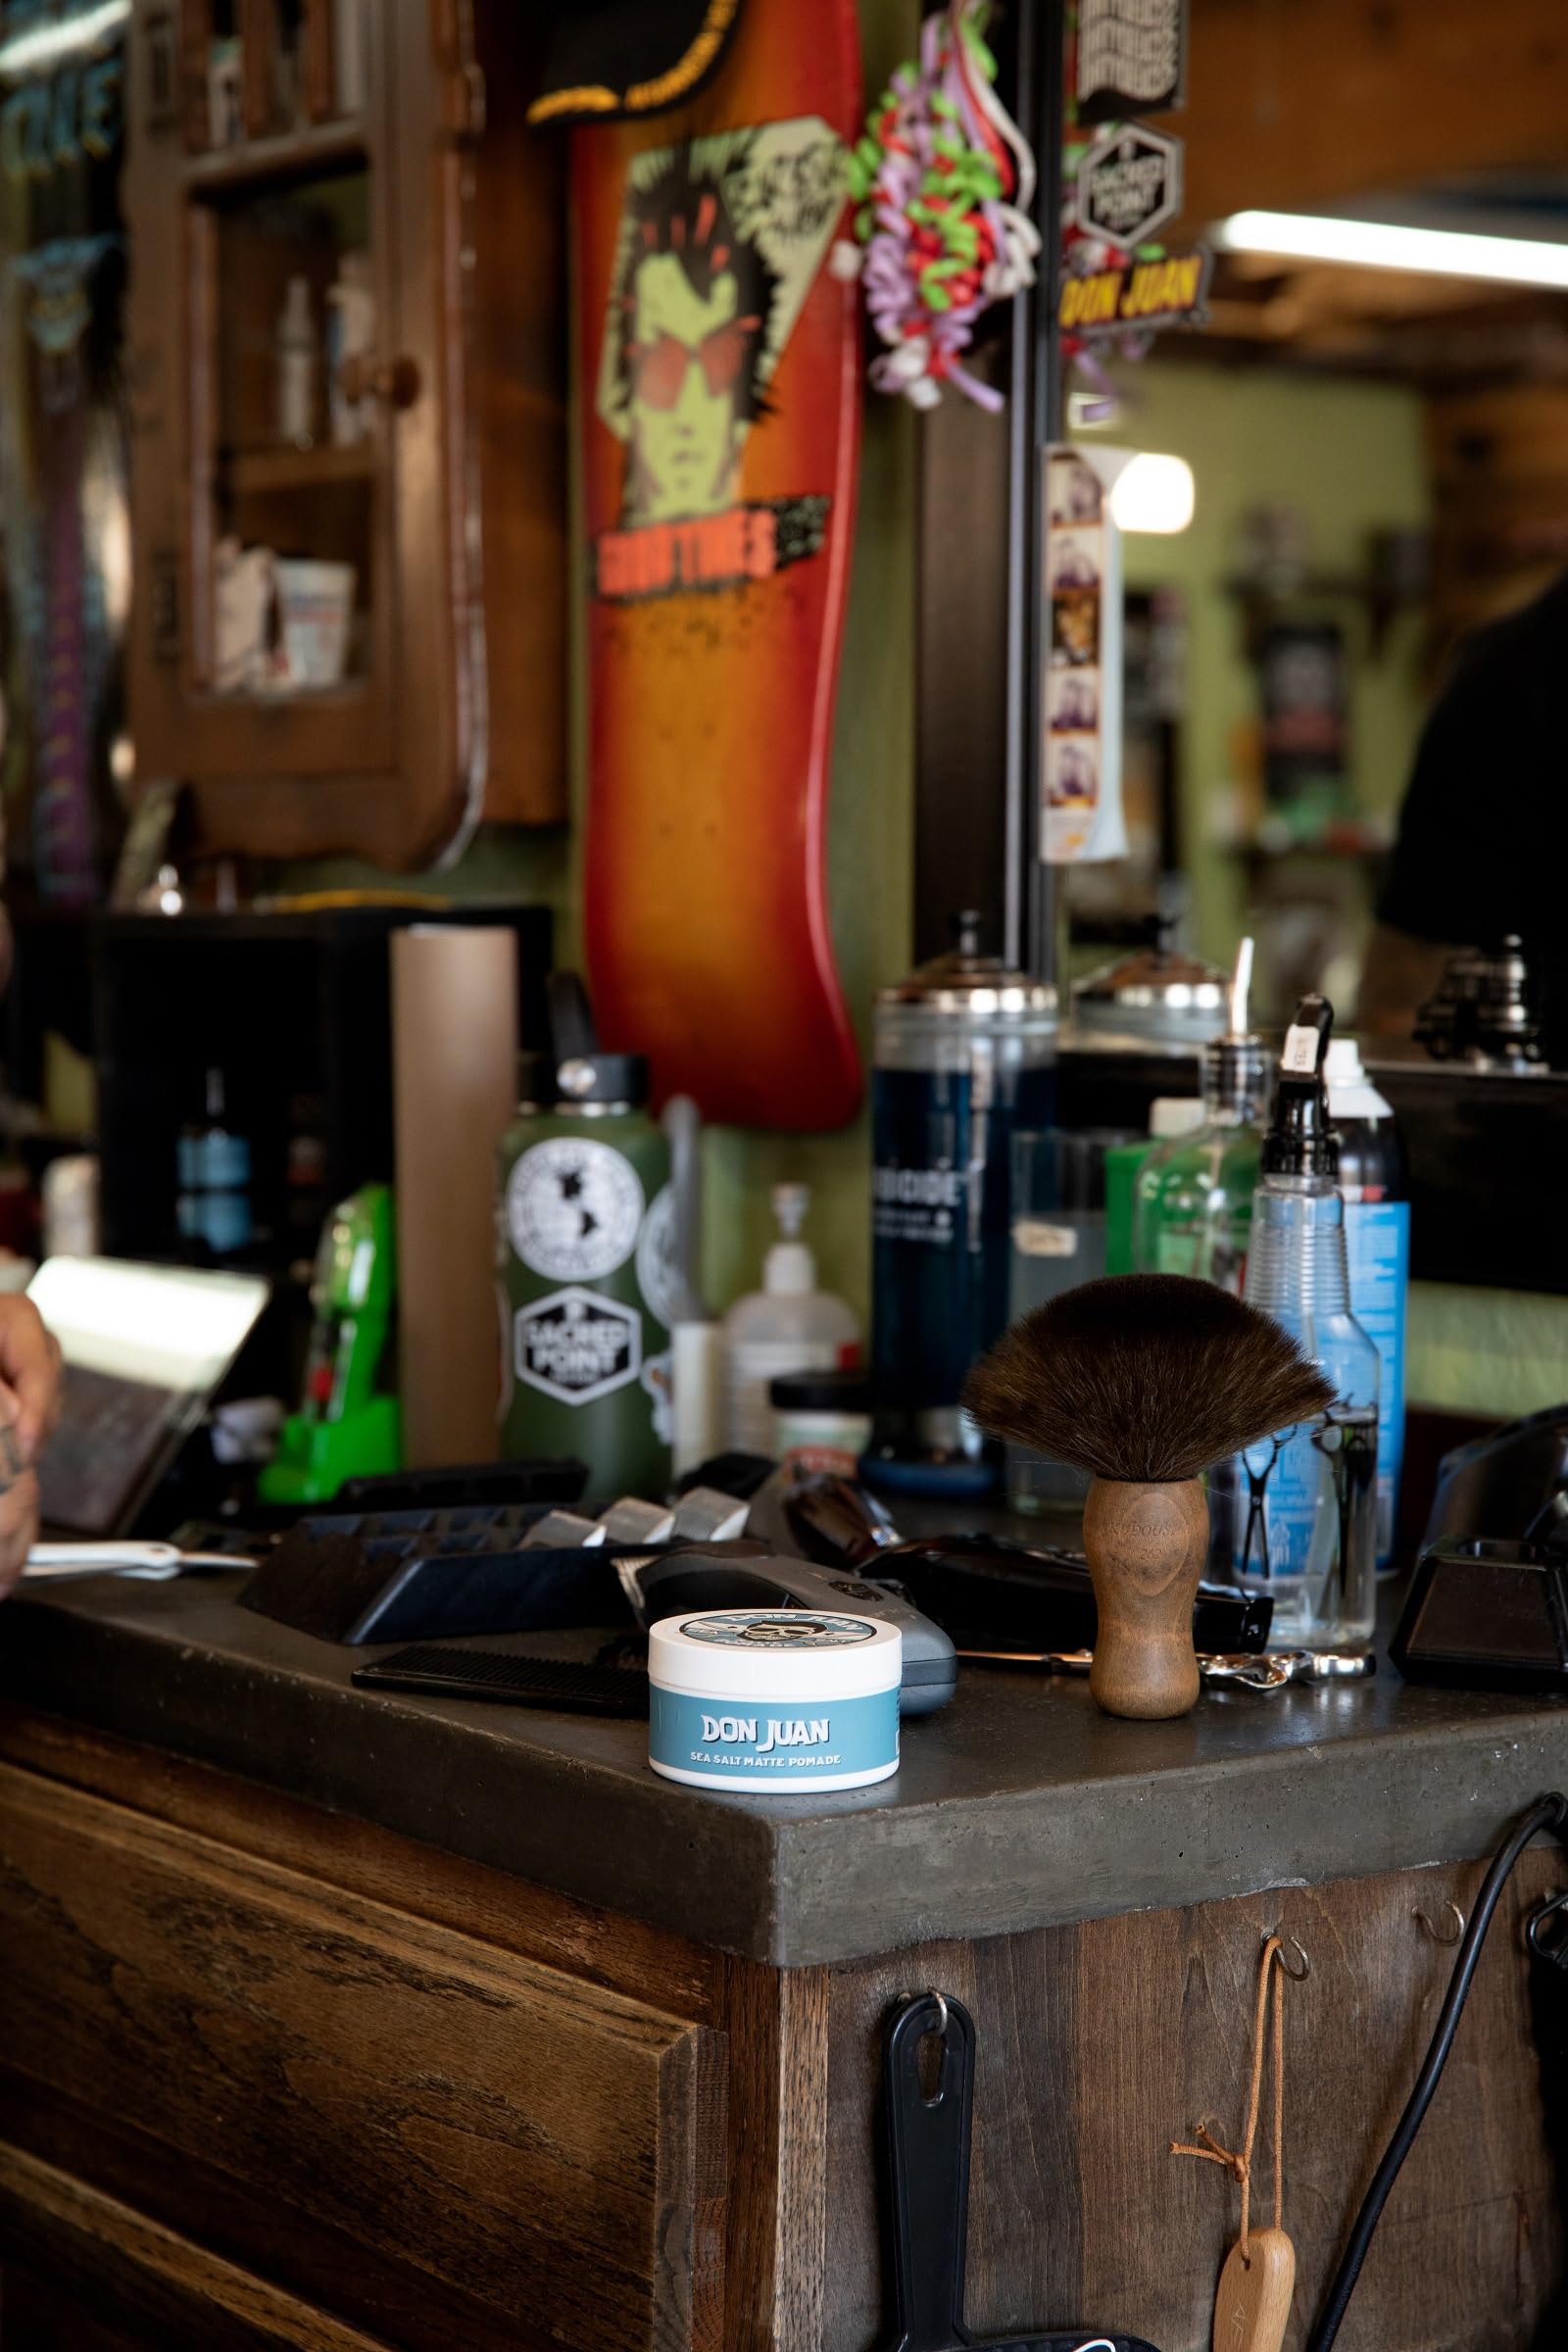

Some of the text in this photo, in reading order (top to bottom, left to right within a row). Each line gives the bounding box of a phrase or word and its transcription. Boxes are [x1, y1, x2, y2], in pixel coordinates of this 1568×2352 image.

[1059, 255, 1202, 328] DON JUAN
[524, 1320, 629, 1349] SACRED
[532, 1348, 616, 1374] POINT
[724, 1612, 863, 1631] DON JUAN
[700, 1714, 831, 1754] DON JUAN
[690, 1751, 842, 1768] SEA SALT MATTE POMADE
